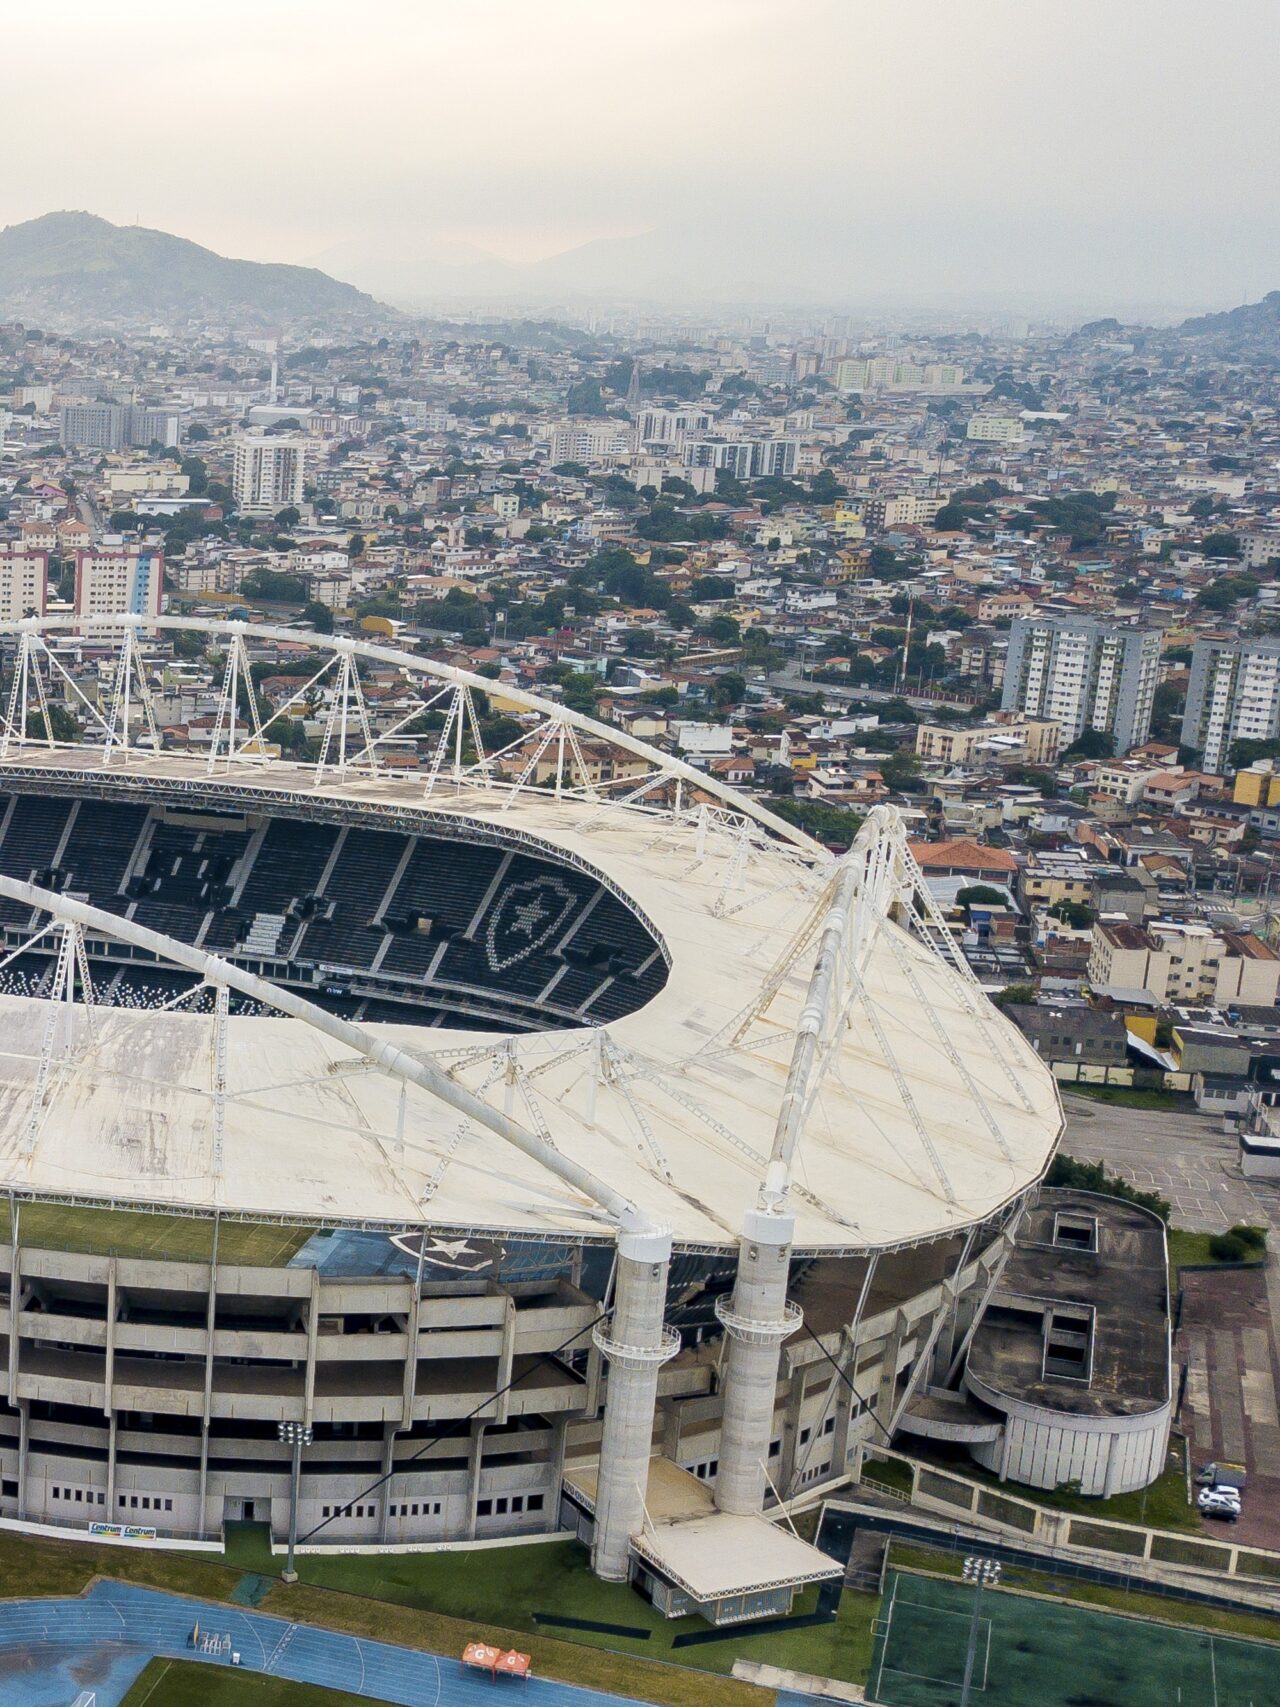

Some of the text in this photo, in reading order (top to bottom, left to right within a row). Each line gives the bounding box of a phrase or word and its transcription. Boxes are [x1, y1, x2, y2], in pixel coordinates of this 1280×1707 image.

[91, 1523, 155, 1535] Centrum Centrum
[475, 1649, 484, 1659] G
[507, 1656, 516, 1664] G
